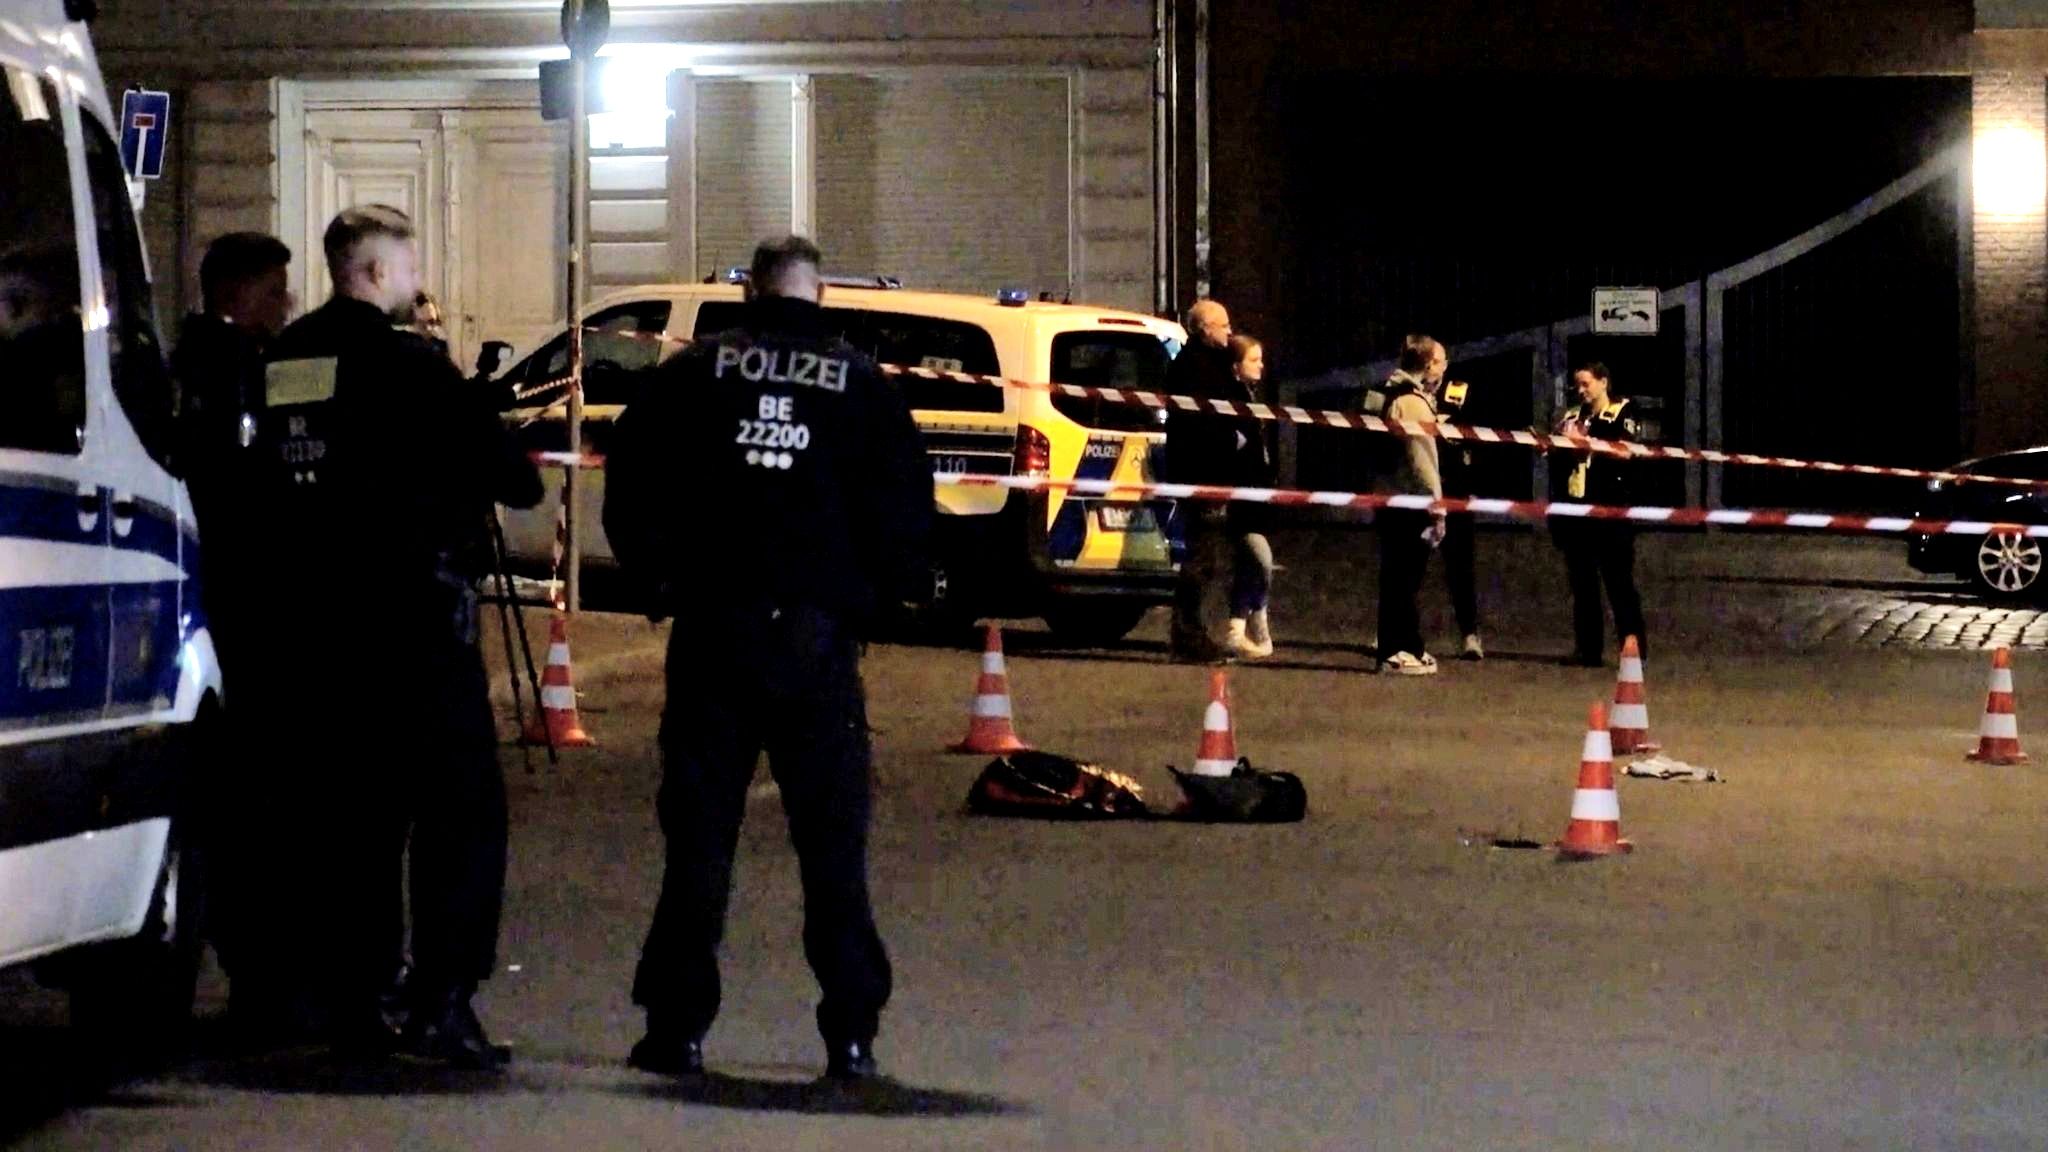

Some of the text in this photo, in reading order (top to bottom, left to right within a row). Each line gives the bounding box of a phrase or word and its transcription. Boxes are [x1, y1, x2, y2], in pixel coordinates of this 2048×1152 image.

[715, 346, 849, 392] POLIZEI
[759, 394, 794, 422] BE
[736, 419, 810, 451] 22200
